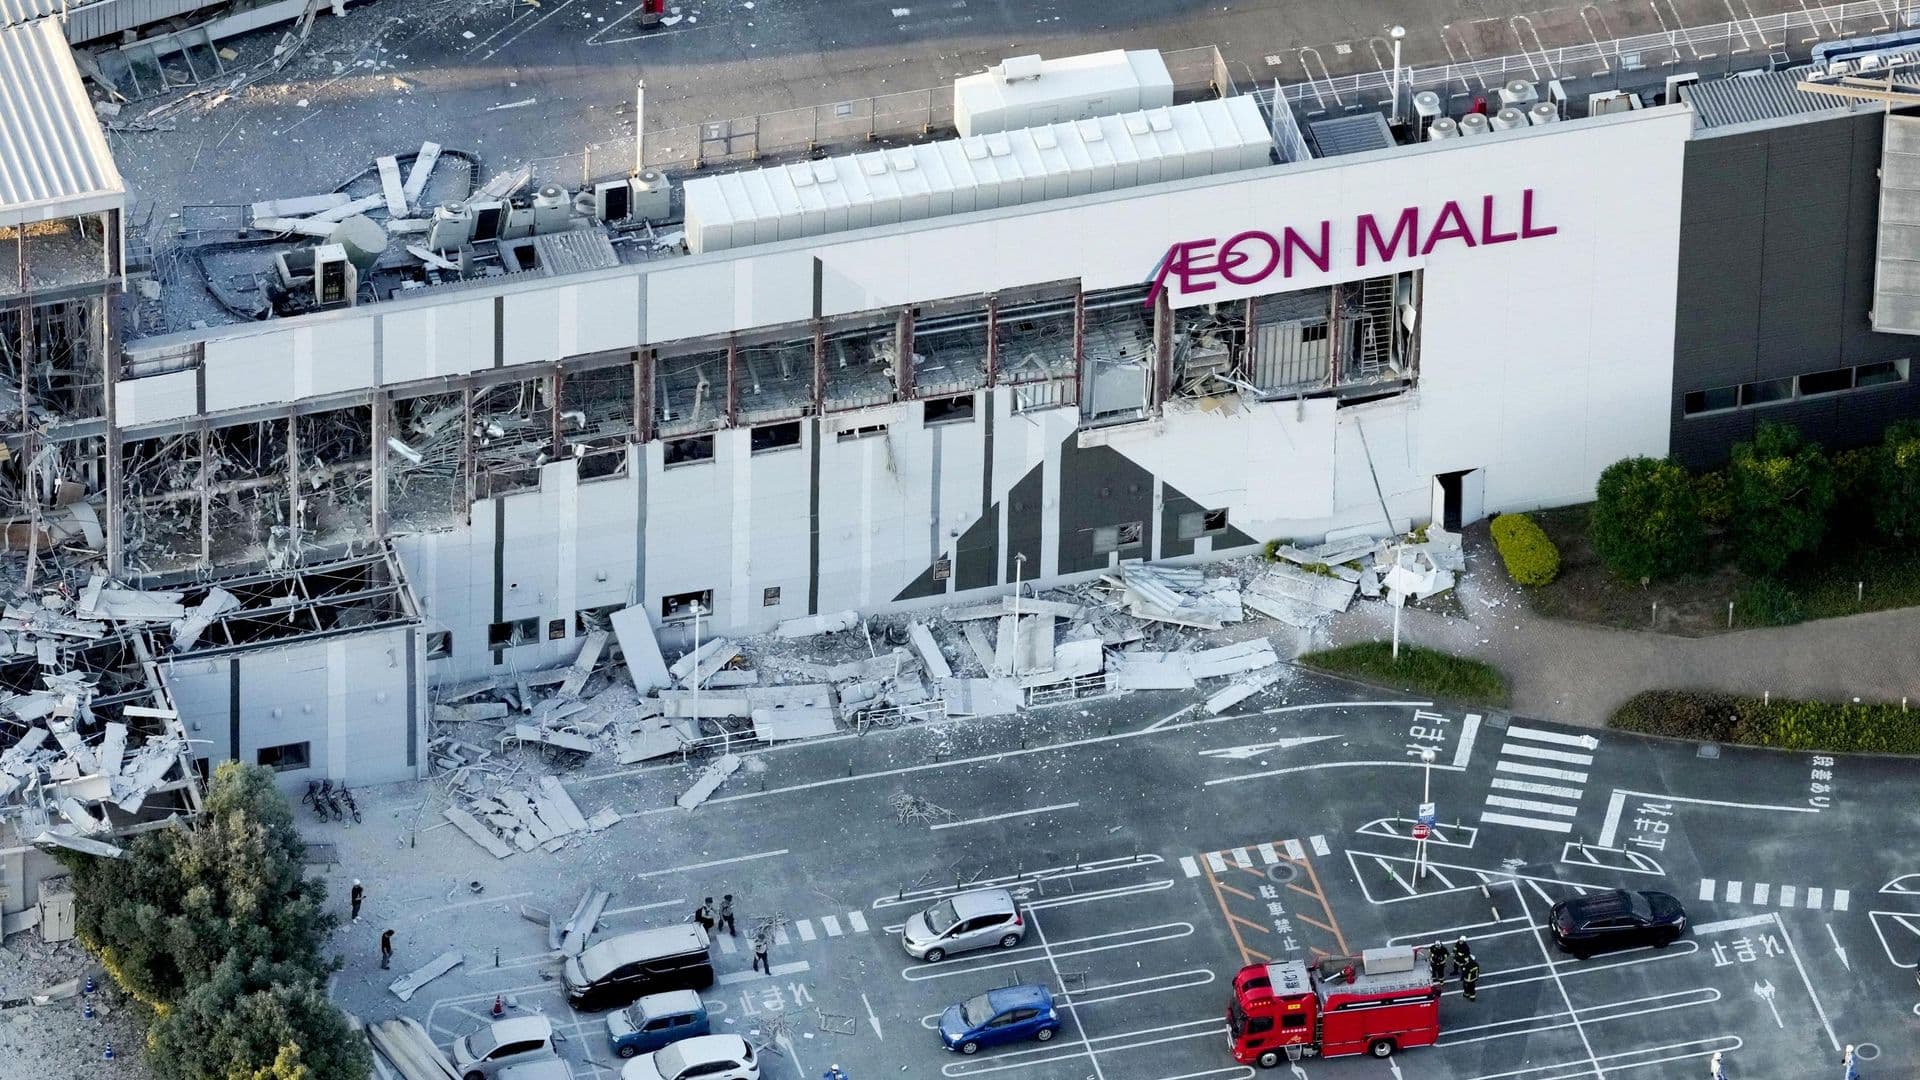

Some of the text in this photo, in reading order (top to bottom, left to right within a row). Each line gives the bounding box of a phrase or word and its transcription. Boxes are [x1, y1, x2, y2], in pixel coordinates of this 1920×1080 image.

[1356, 188, 1557, 267] MALL
[1628, 803, 1673, 851] 止まれ
[1258, 884, 1301, 951] 駐車禁止
[1711, 933, 1785, 967] 止まれ
[739, 982, 814, 1016] 止まれ
